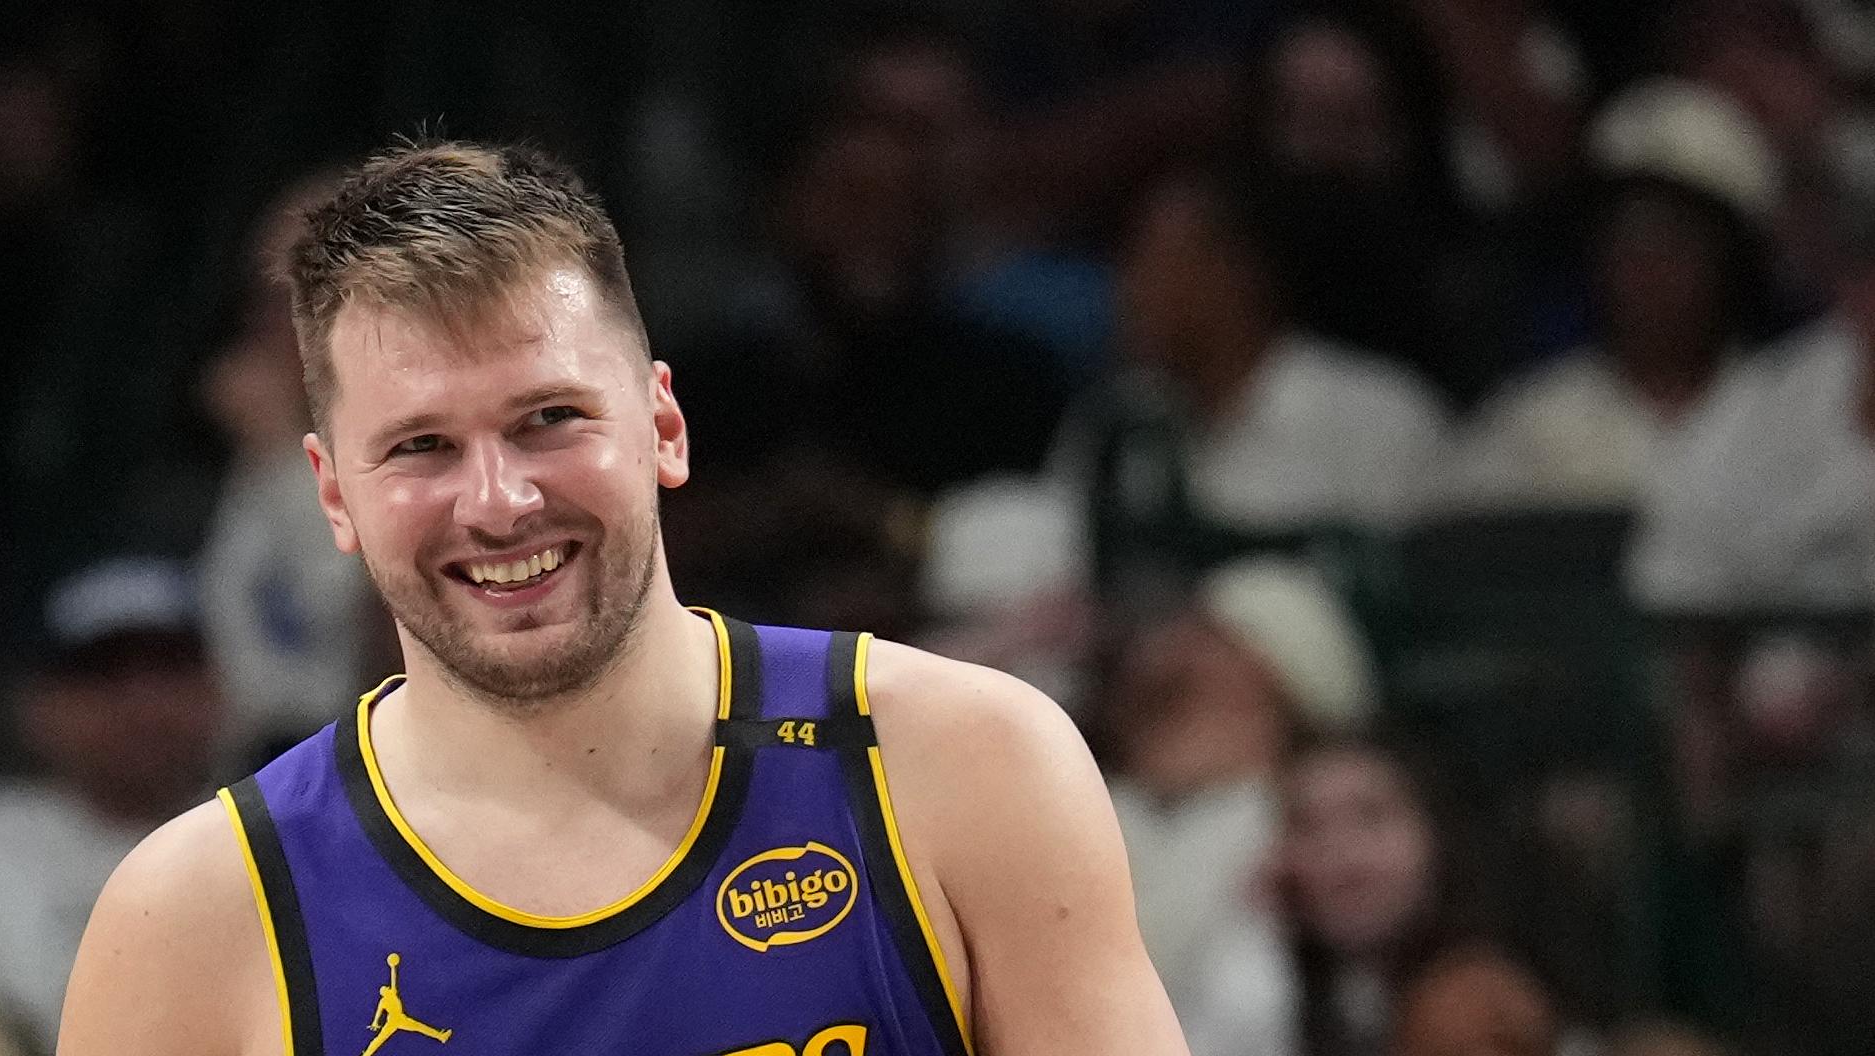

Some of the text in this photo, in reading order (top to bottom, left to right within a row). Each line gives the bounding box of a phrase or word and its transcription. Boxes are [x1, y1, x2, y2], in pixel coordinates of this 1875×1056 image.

[777, 721, 815, 745] 44
[728, 869, 847, 918] bibigo
[754, 904, 805, 928] 비비고
